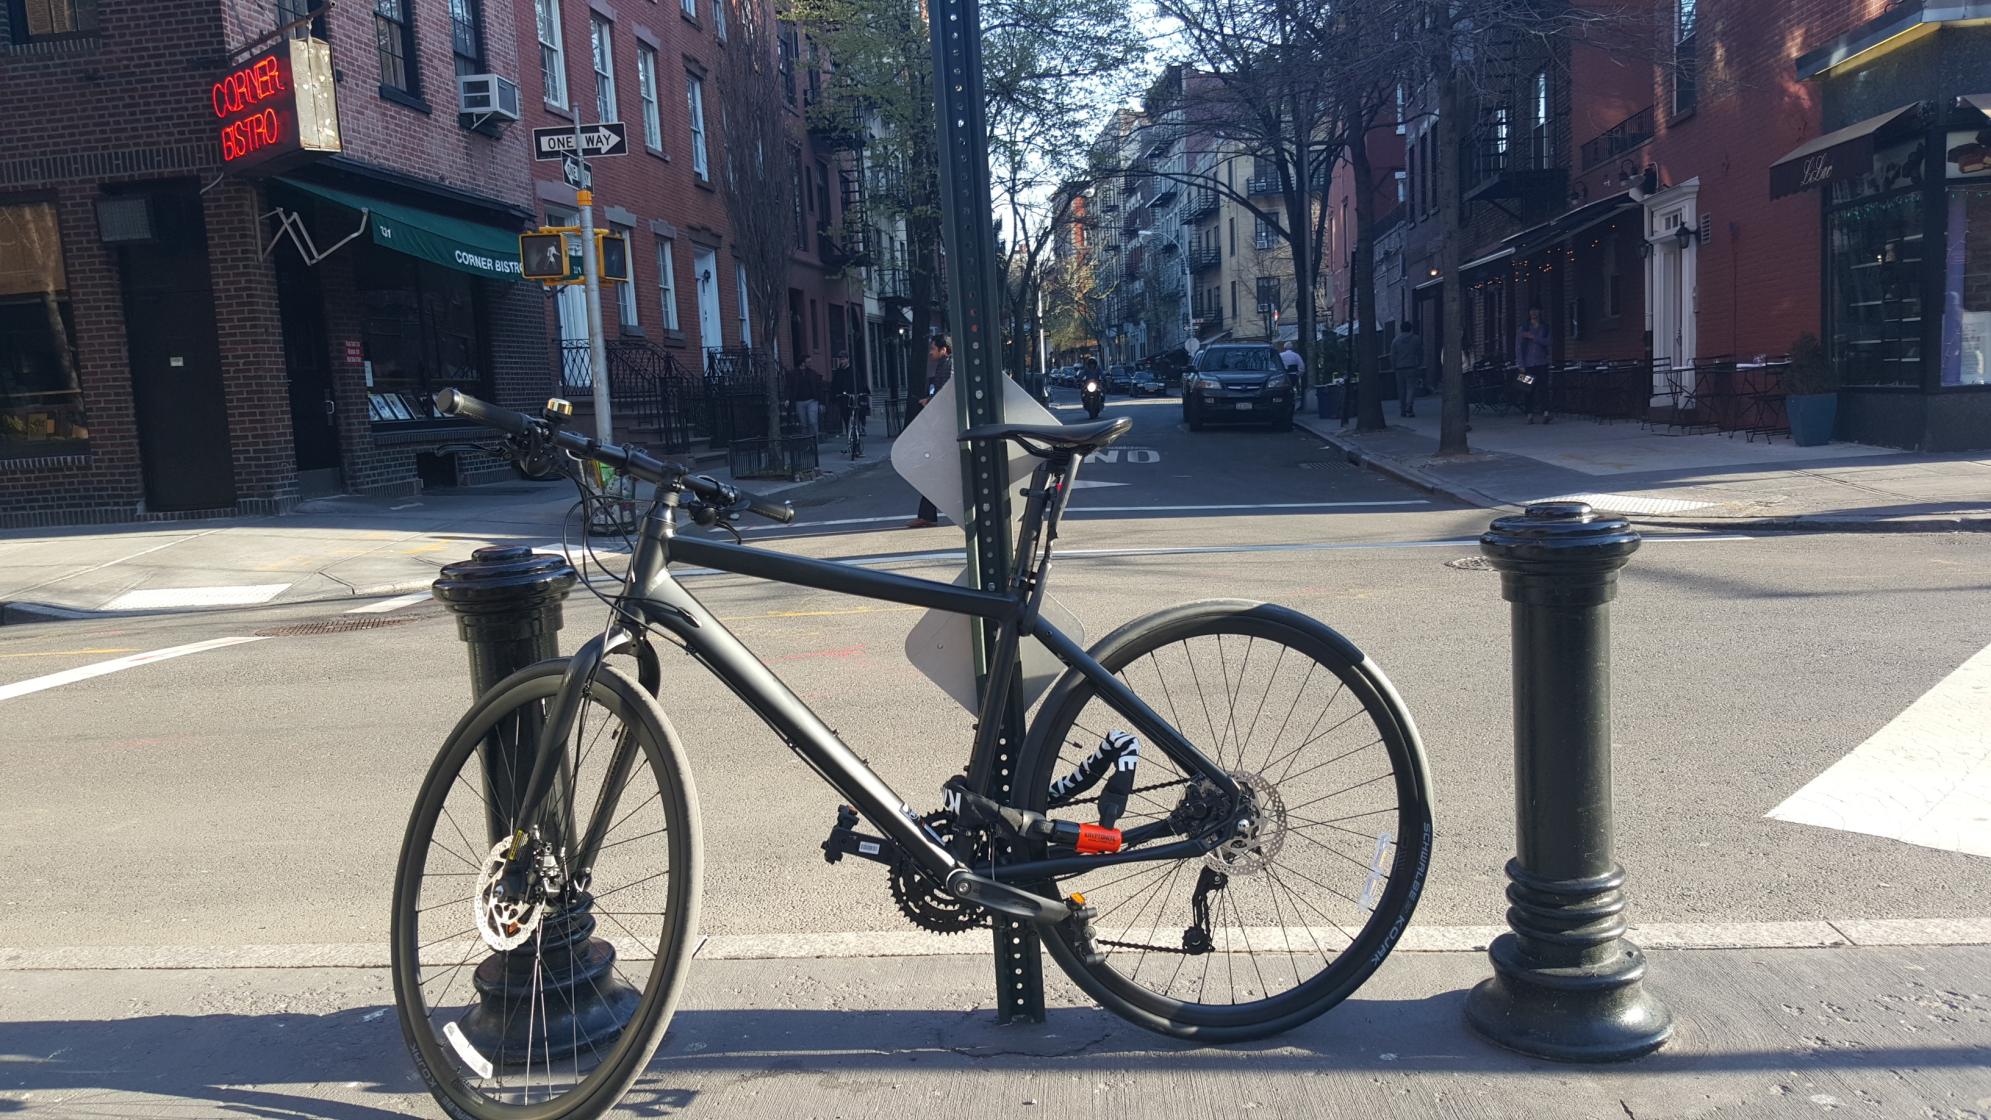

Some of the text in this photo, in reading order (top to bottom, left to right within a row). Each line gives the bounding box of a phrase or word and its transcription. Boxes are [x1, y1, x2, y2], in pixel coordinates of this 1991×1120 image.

[213, 55, 286, 119] CORNER
[222, 108, 278, 161] BISTRO
[547, 133, 611, 150] ONE WAY
[455, 250, 493, 269] CORNER
[1371, 822, 1431, 966] SCHWALBE KOJAK
